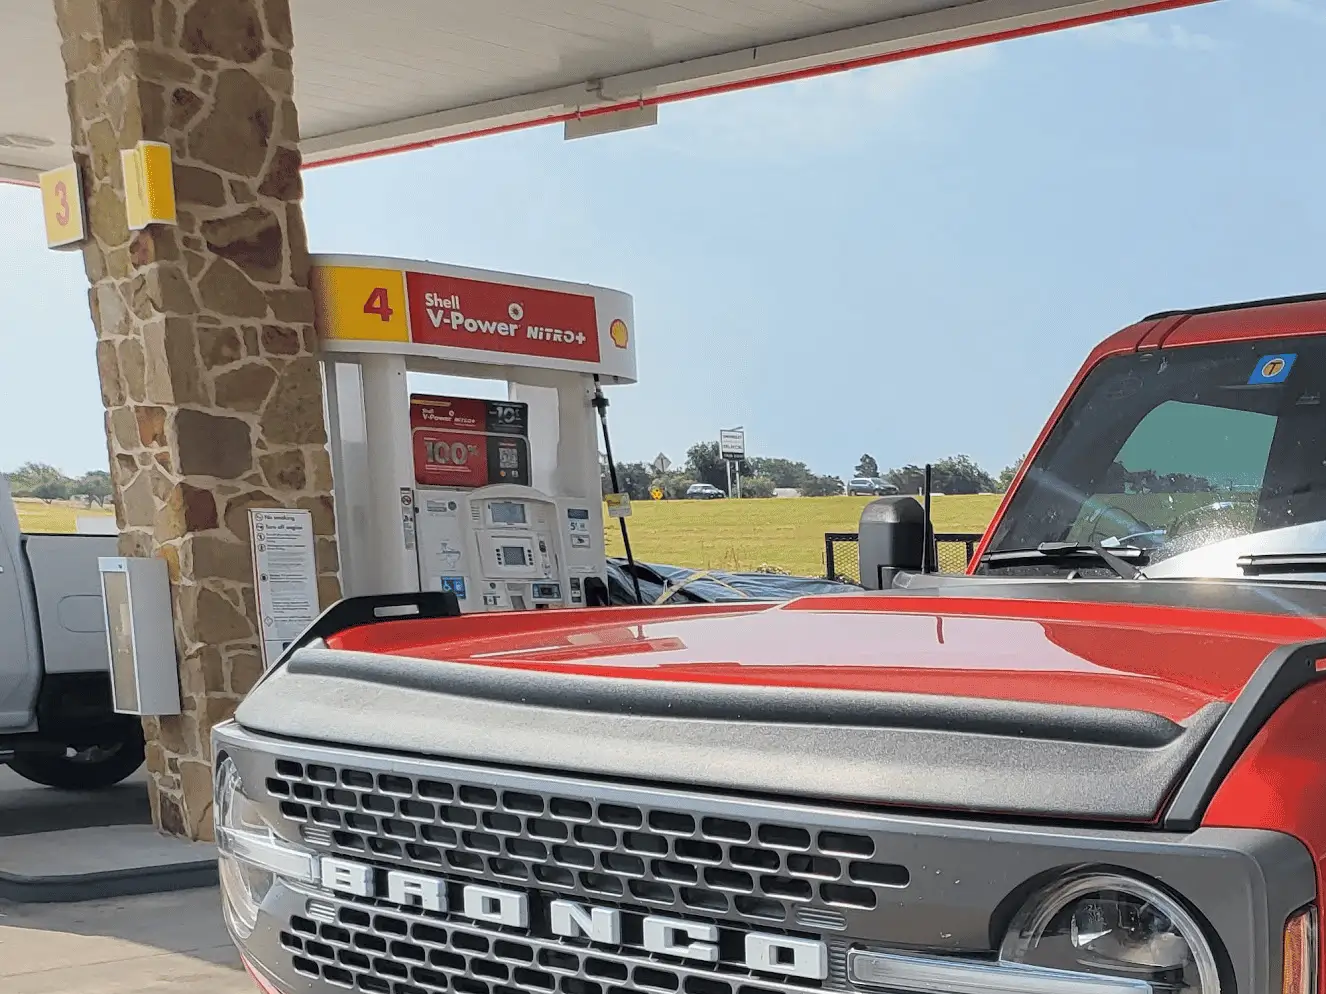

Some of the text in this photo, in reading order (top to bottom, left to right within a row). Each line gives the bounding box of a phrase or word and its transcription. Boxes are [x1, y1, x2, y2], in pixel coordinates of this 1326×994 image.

[54, 180, 70, 226] 3
[363, 287, 393, 322] 4
[425, 292, 460, 310] Shell
[425, 308, 518, 337] V-Power
[320, 856, 829, 981] BRONCO
